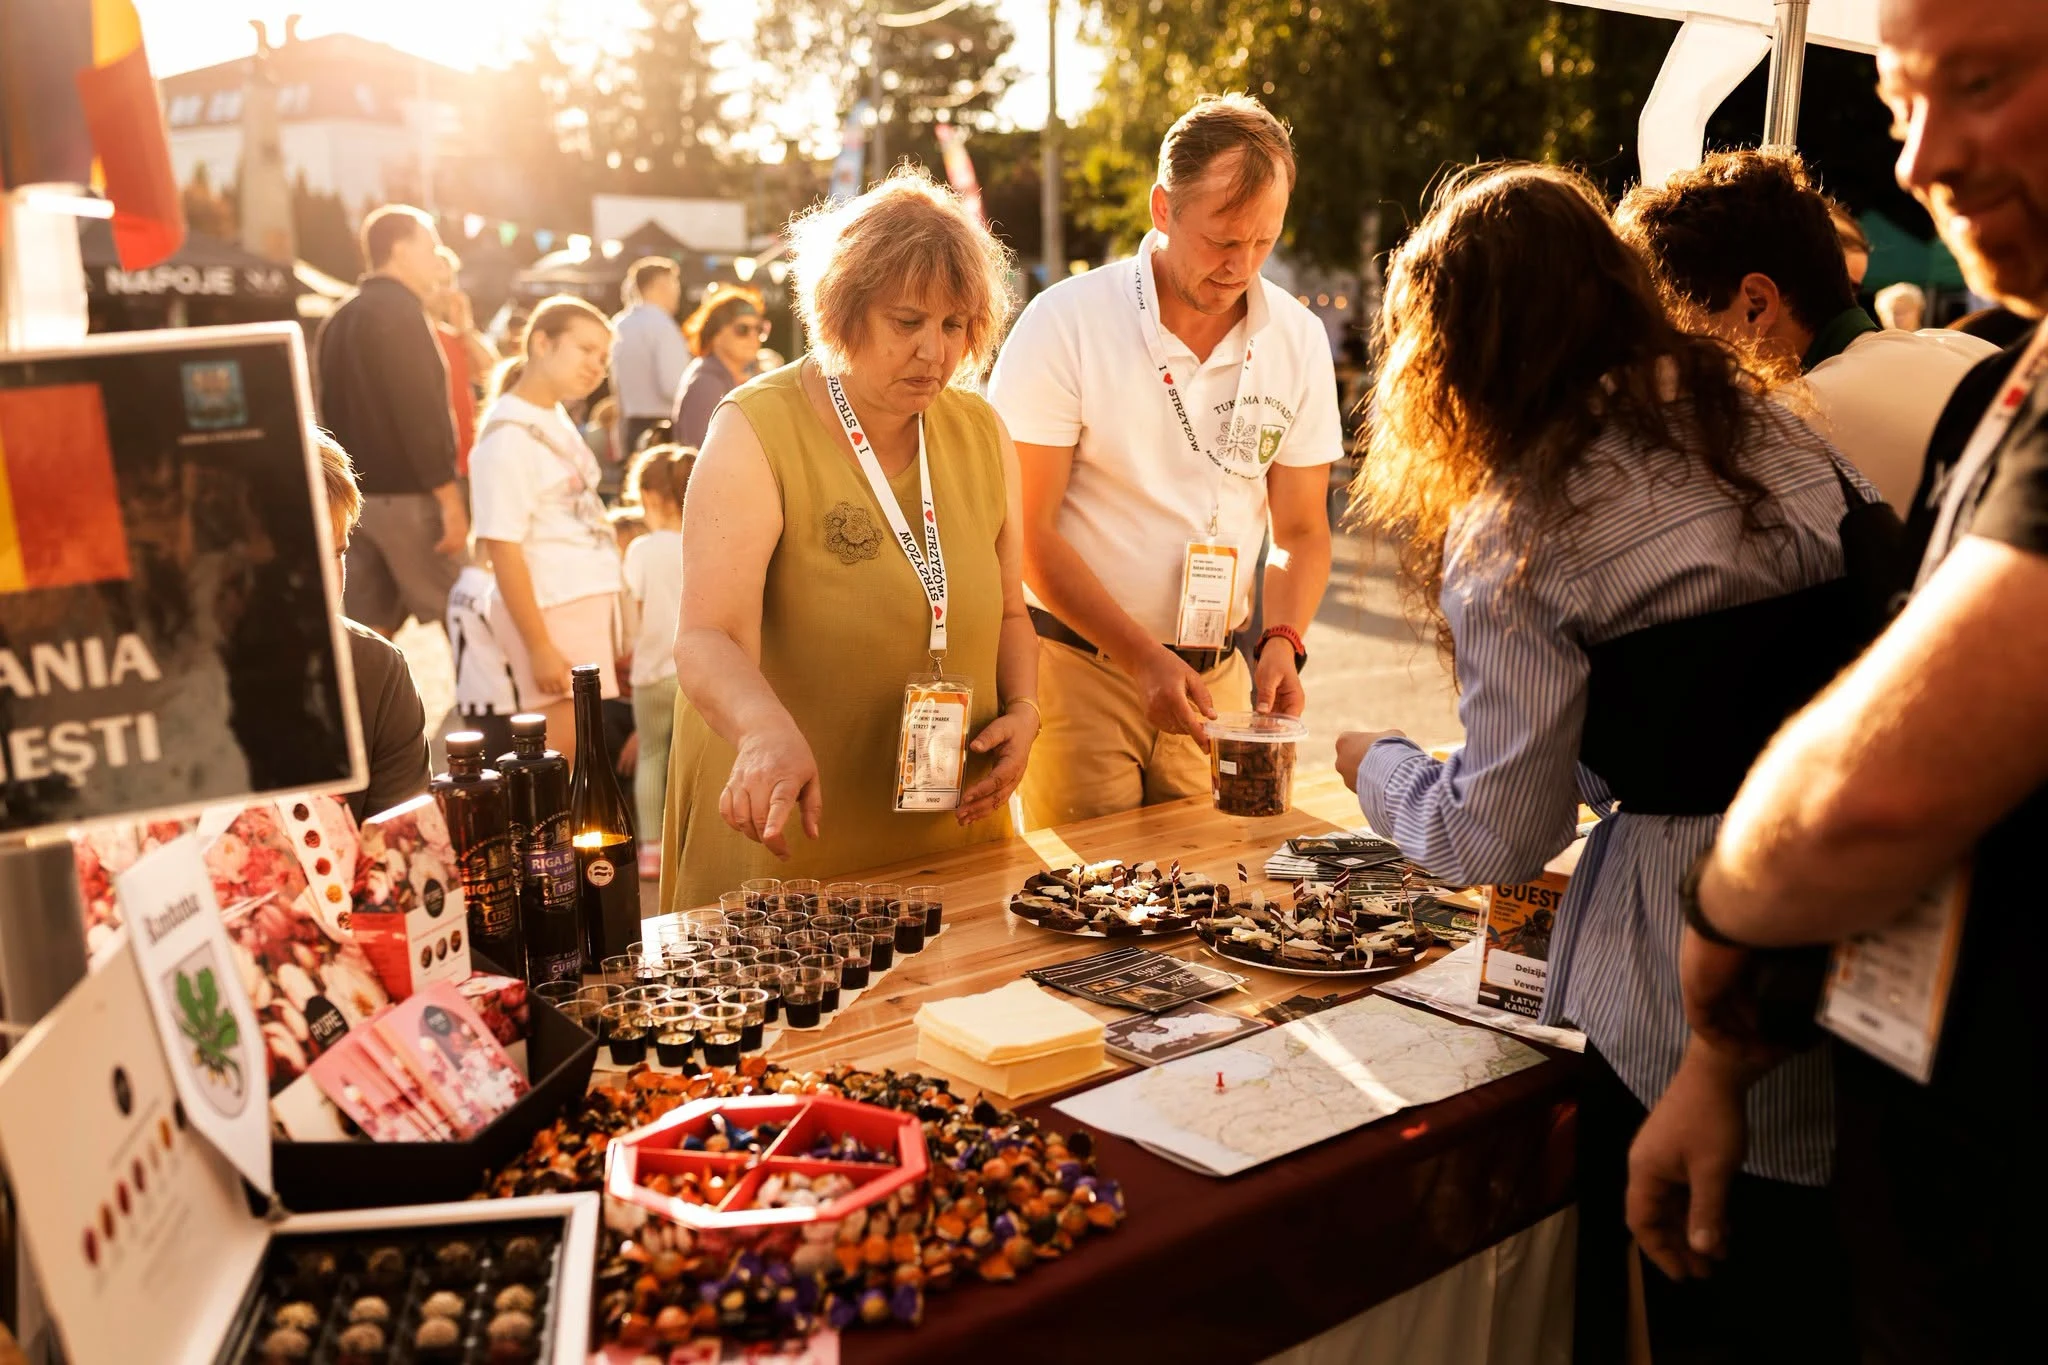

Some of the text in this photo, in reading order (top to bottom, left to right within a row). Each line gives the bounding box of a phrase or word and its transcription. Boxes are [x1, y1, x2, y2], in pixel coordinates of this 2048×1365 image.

[828, 375, 857, 428] STRZYŻ
[531, 856, 562, 870] RIGA
[463, 881, 496, 897] RIGA
[1497, 884, 1563, 911] GUEST
